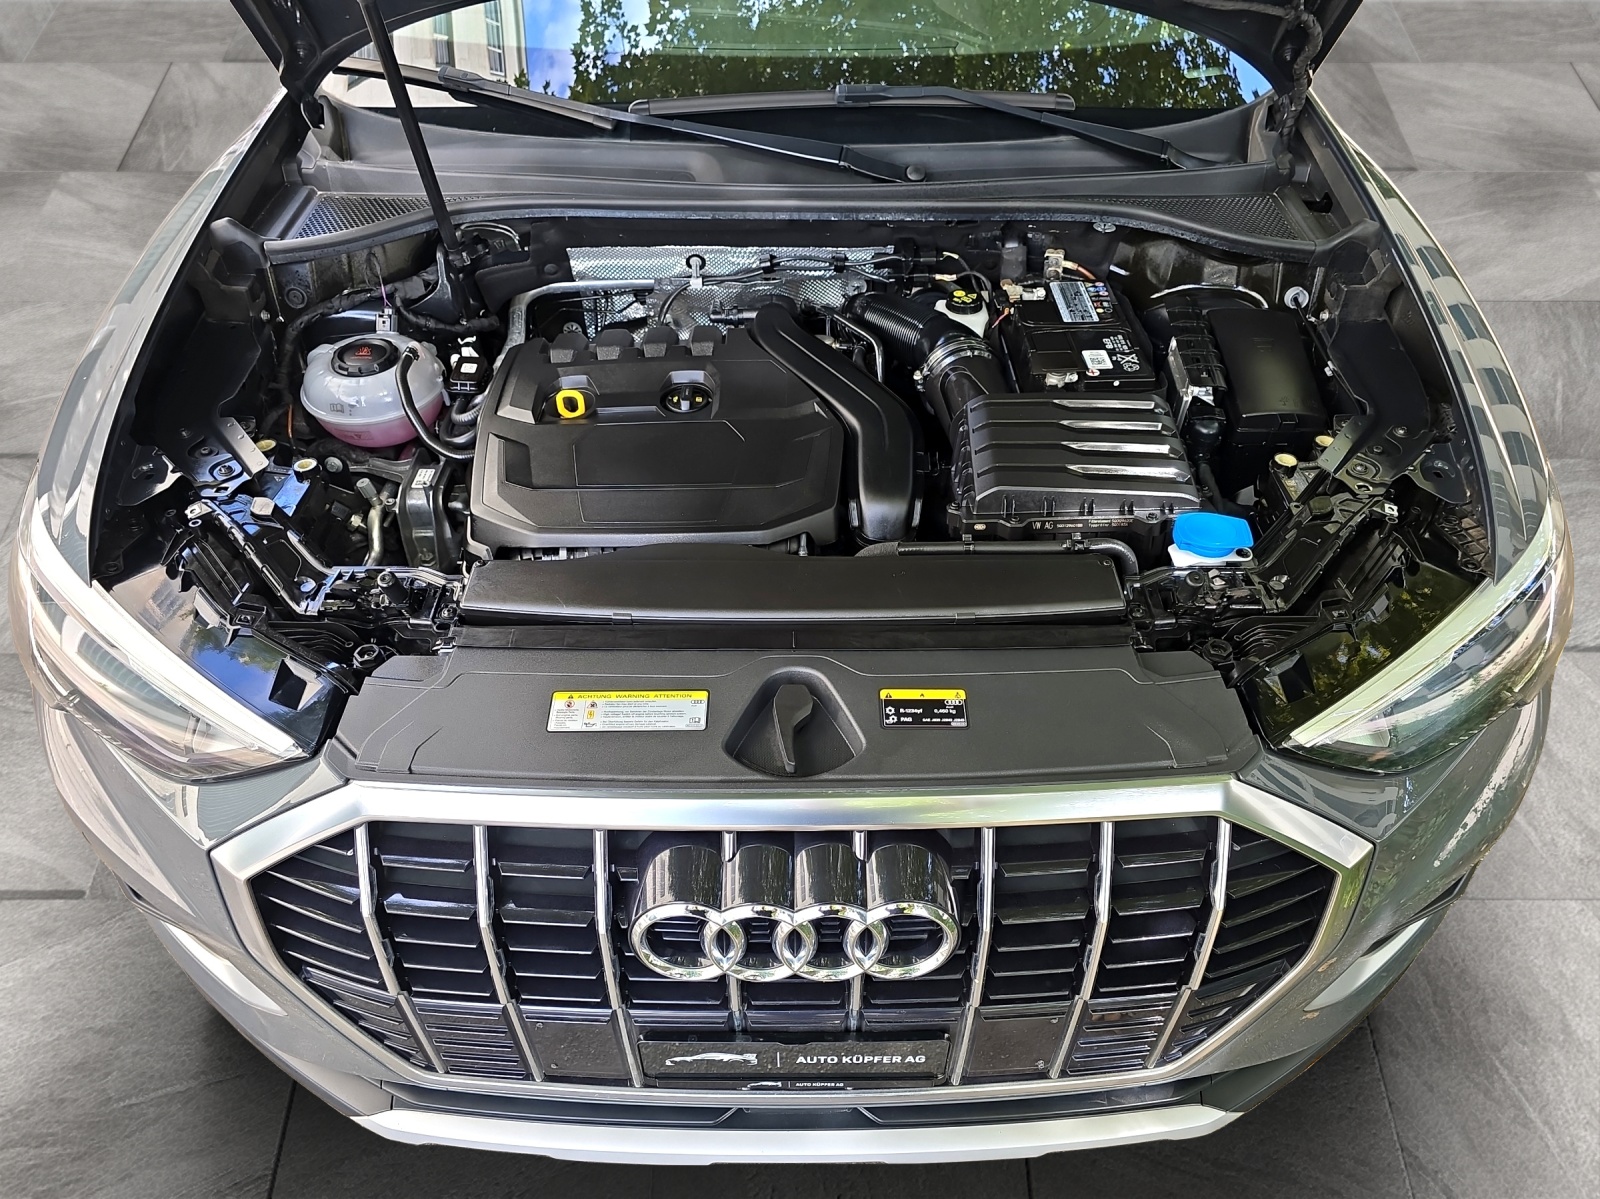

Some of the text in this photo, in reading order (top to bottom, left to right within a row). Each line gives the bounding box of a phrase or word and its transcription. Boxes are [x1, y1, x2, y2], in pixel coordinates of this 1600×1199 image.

[1044, 521, 1054, 529] AG
[796, 1055, 926, 1064] AUTO KÜPFER AG
